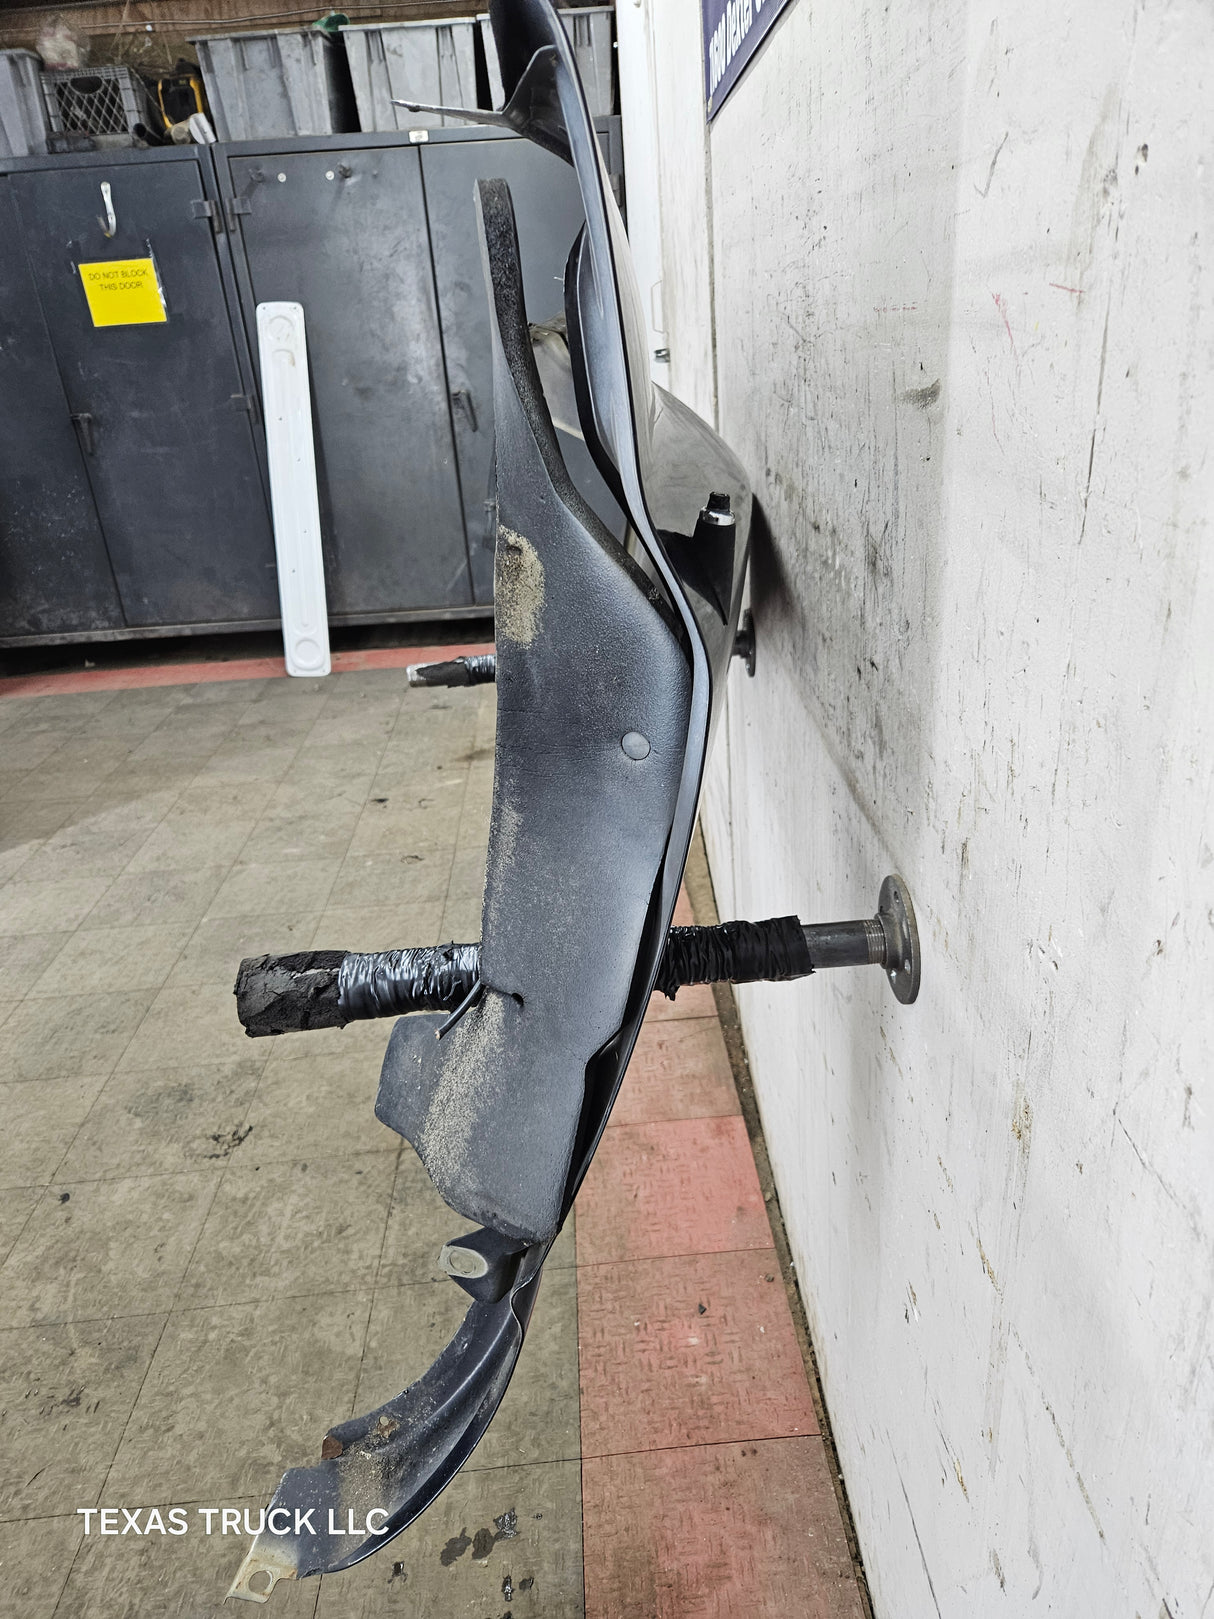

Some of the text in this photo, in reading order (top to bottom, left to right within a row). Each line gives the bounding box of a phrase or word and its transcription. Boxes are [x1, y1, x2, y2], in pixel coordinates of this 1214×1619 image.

[88, 268, 148, 281] DO NOT BLOCK
[99, 281, 143, 291] THIS DOOR
